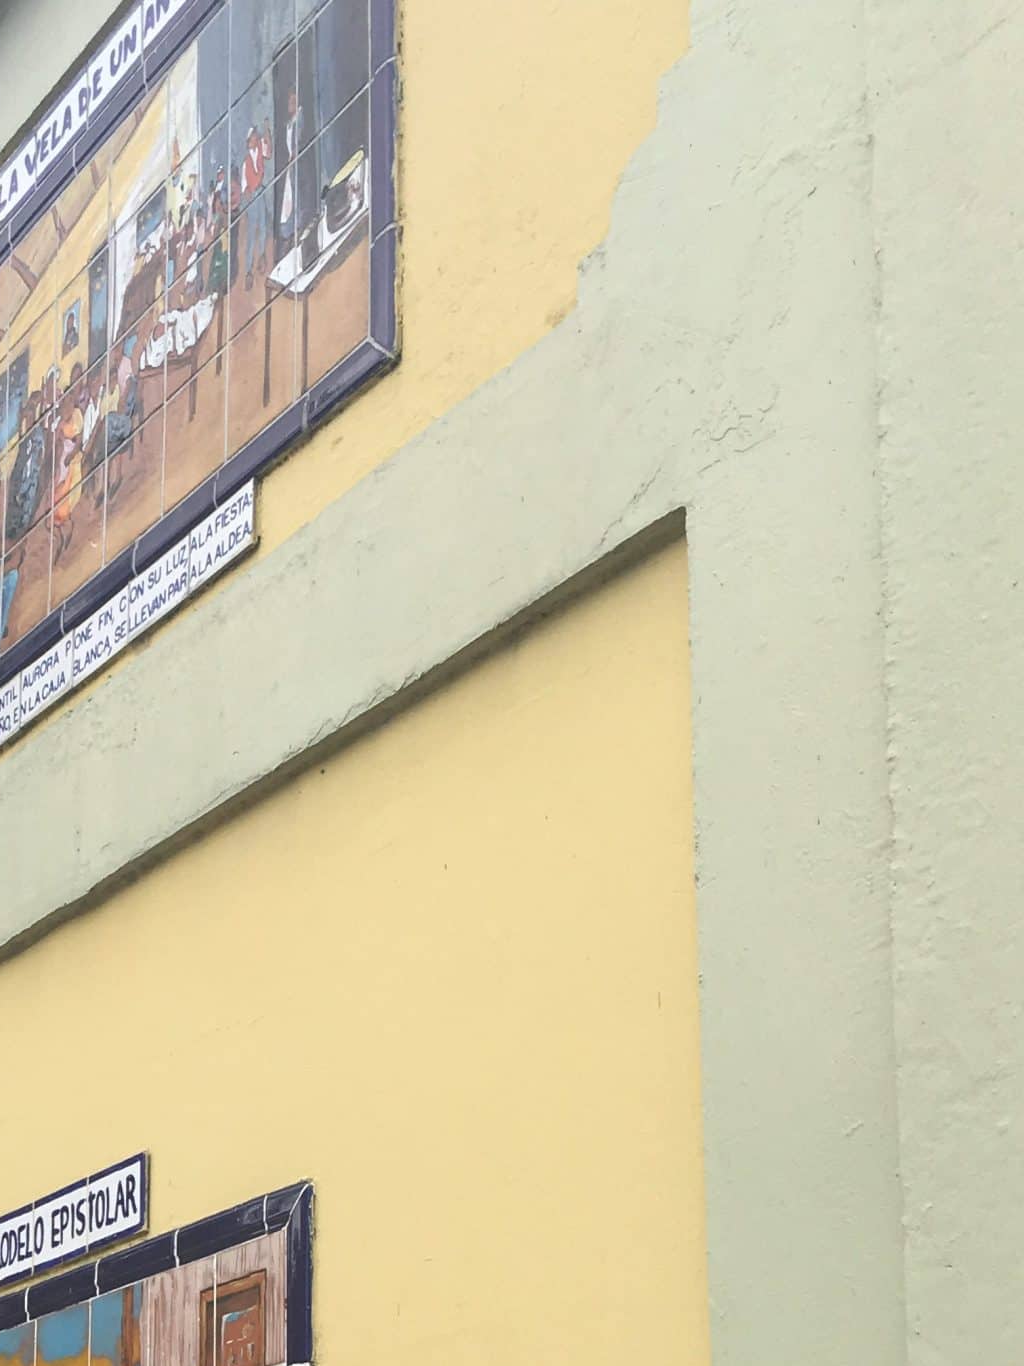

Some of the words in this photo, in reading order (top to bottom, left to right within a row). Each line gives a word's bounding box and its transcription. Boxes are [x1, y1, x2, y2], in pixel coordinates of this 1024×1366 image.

[24, 105, 72, 176] VELA
[78, 66, 103, 119] DE
[109, 24, 137, 77] UN
[22, 652, 59, 691] AURORA
[65, 622, 93, 656] PONE
[119, 582, 145, 613] CON
[147, 566, 162, 590] SU
[41, 671, 66, 700] CAJA
[114, 620, 127, 644] SE
[128, 589, 167, 633] LLEVAN
[51, 1174, 137, 1249] EPISTOLAR
